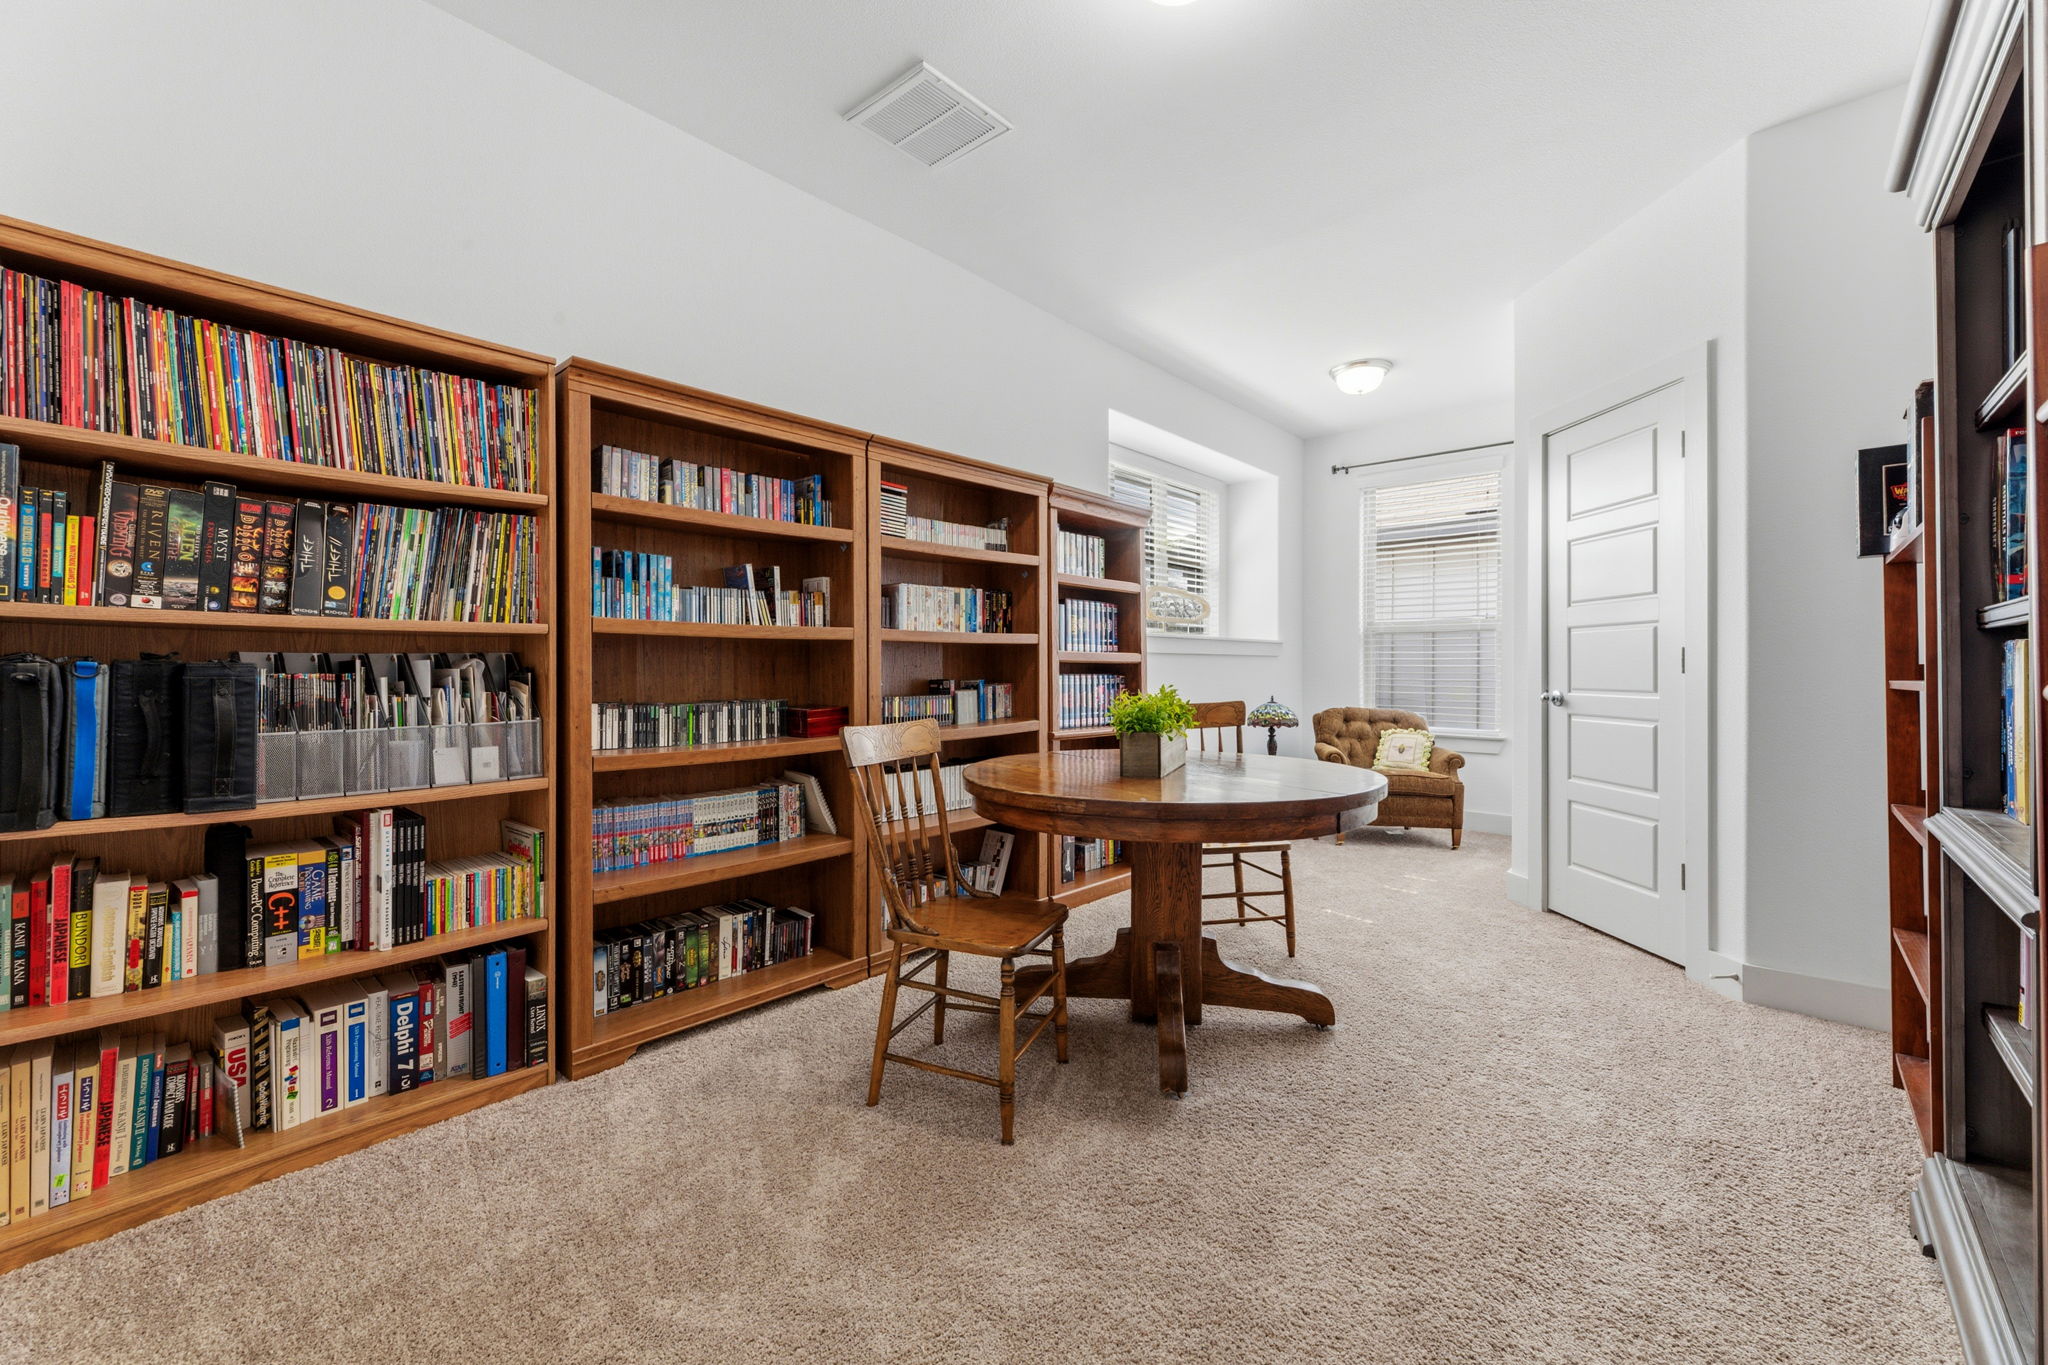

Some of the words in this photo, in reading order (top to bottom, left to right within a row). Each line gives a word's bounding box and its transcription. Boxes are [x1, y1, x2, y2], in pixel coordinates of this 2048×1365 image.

[148, 509, 164, 561] RIVEN
[179, 518, 196, 562] ALIEN
[216, 527, 229, 562] MYST
[298, 534, 316, 573] THIEF
[326, 544, 343, 583] THIEF
[268, 874, 296, 884] Complete
[268, 880, 294, 889] Reference
[311, 869, 325, 903] GAME
[327, 873, 338, 903] Techniques
[268, 891, 296, 930] C++
[15, 922, 26, 948] KANJI
[53, 918, 67, 964] JAPANESE
[74, 913, 88, 966] BUNDORI
[248, 914, 263, 957] Computing
[14, 949, 26, 958] &
[14, 959, 26, 985] KANA
[396, 1001, 414, 1056] Delphi
[536, 1004, 546, 1033] LINUX
[374, 1025, 382, 1058] RENDERING
[228, 1047, 247, 1088] USA
[397, 1059, 414, 1070] 7
[120, 1063, 130, 1101] REMEMBERING
[119, 1101, 127, 1112] THE
[134, 1106, 145, 1126] KANJI
[138, 1095, 146, 1106] THE
[150, 1099, 159, 1128] Japanese
[258, 1080, 268, 1125] CodeWarrior
[326, 1098, 334, 1109] 2
[97, 1101, 112, 1147] JAPANESE
[115, 1111, 126, 1134] KANJI
[163, 1115, 173, 1130] GUIDE
[39, 1126, 47, 1152] JAPANESE
